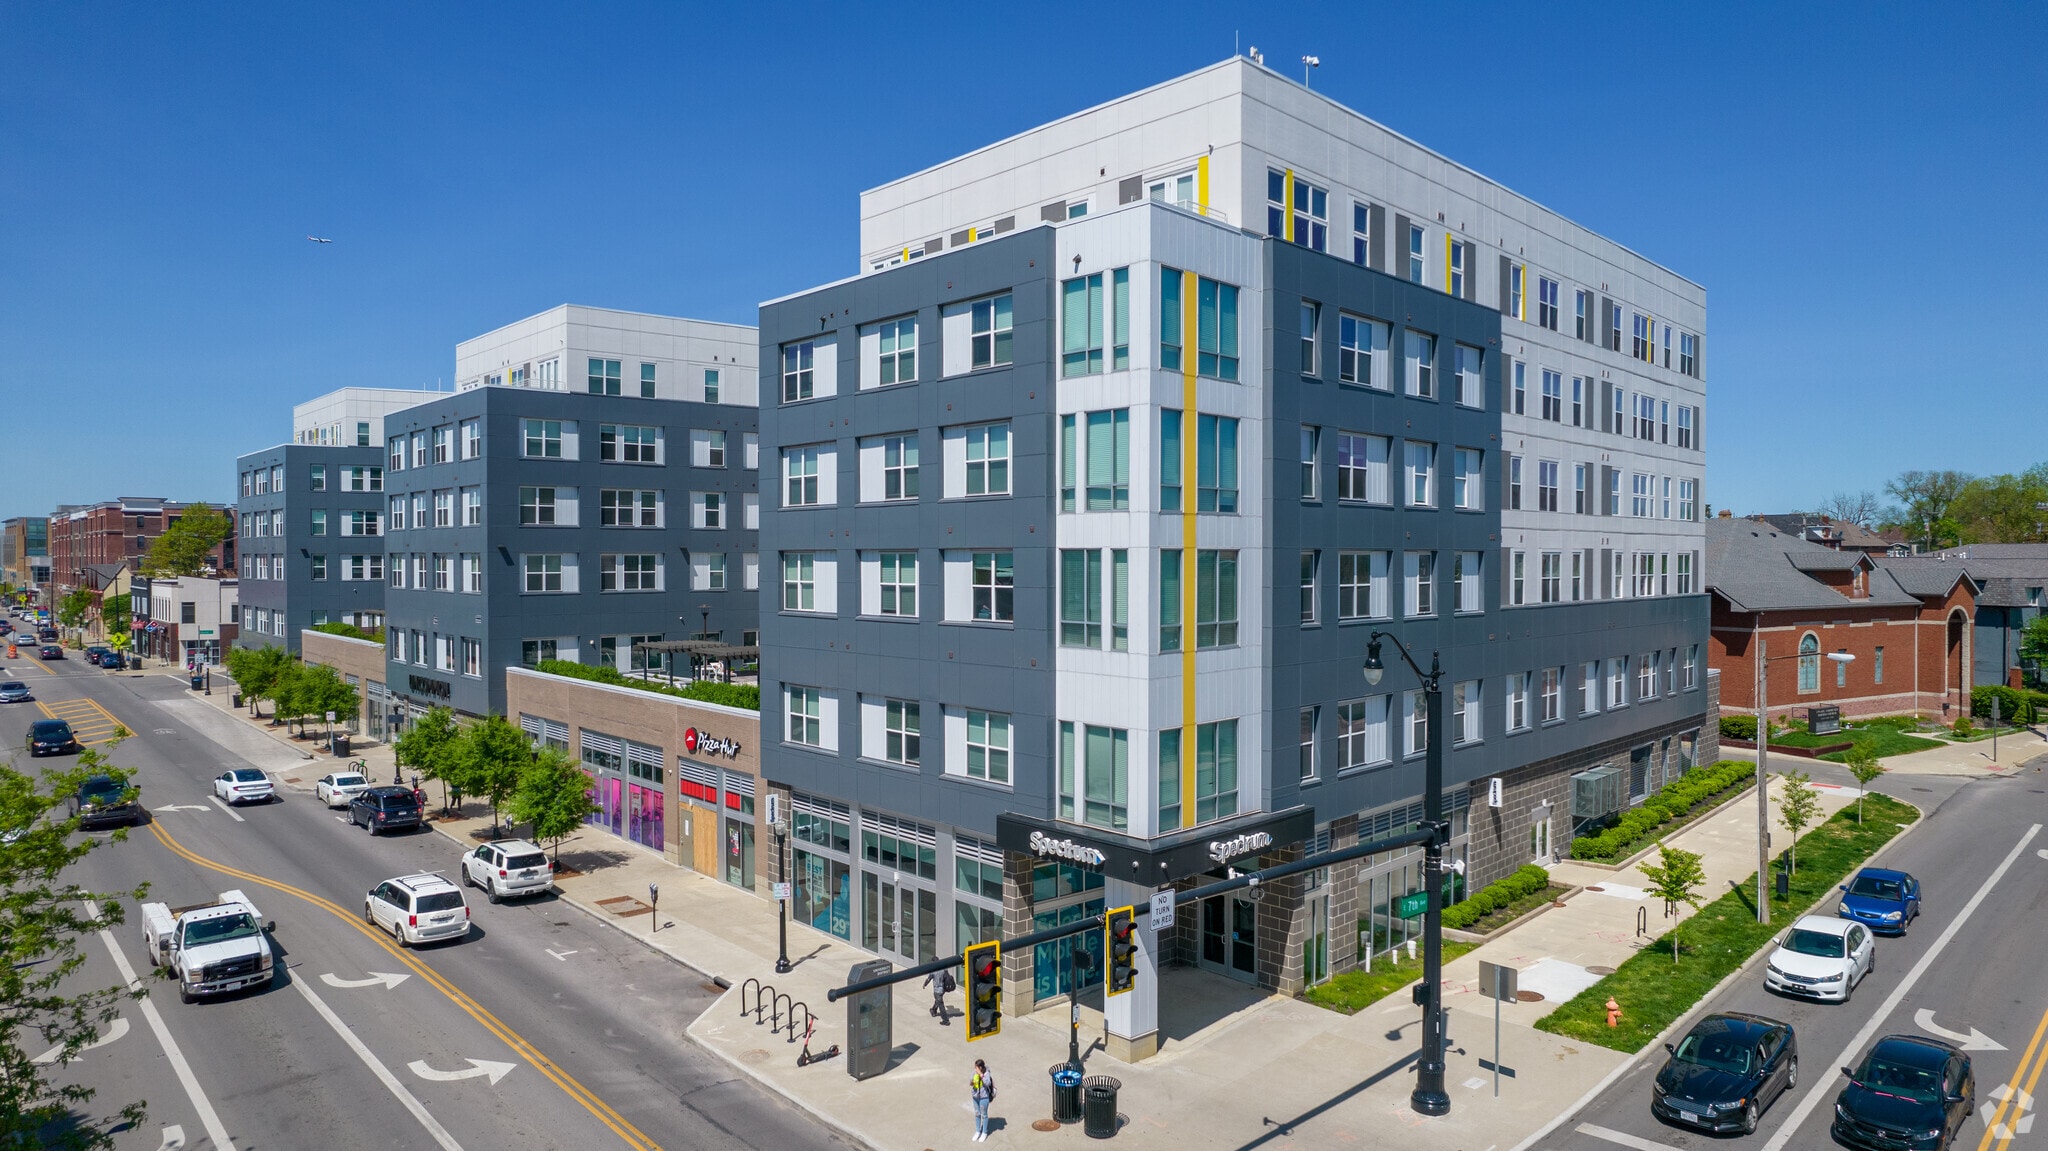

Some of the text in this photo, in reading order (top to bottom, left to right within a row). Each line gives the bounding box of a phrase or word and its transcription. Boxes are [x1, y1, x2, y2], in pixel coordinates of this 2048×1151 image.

[697, 732, 740, 756] Pizza Hut
[1030, 831, 1102, 865] Spectrum
[1209, 832, 1271, 864] Spectrum
[1158, 895, 1168, 904] NO
[1408, 900, 1419, 912] 7th
[1156, 905, 1170, 915] TURN
[1152, 915, 1172, 927] ON RED
[1037, 973, 1051, 993] is
